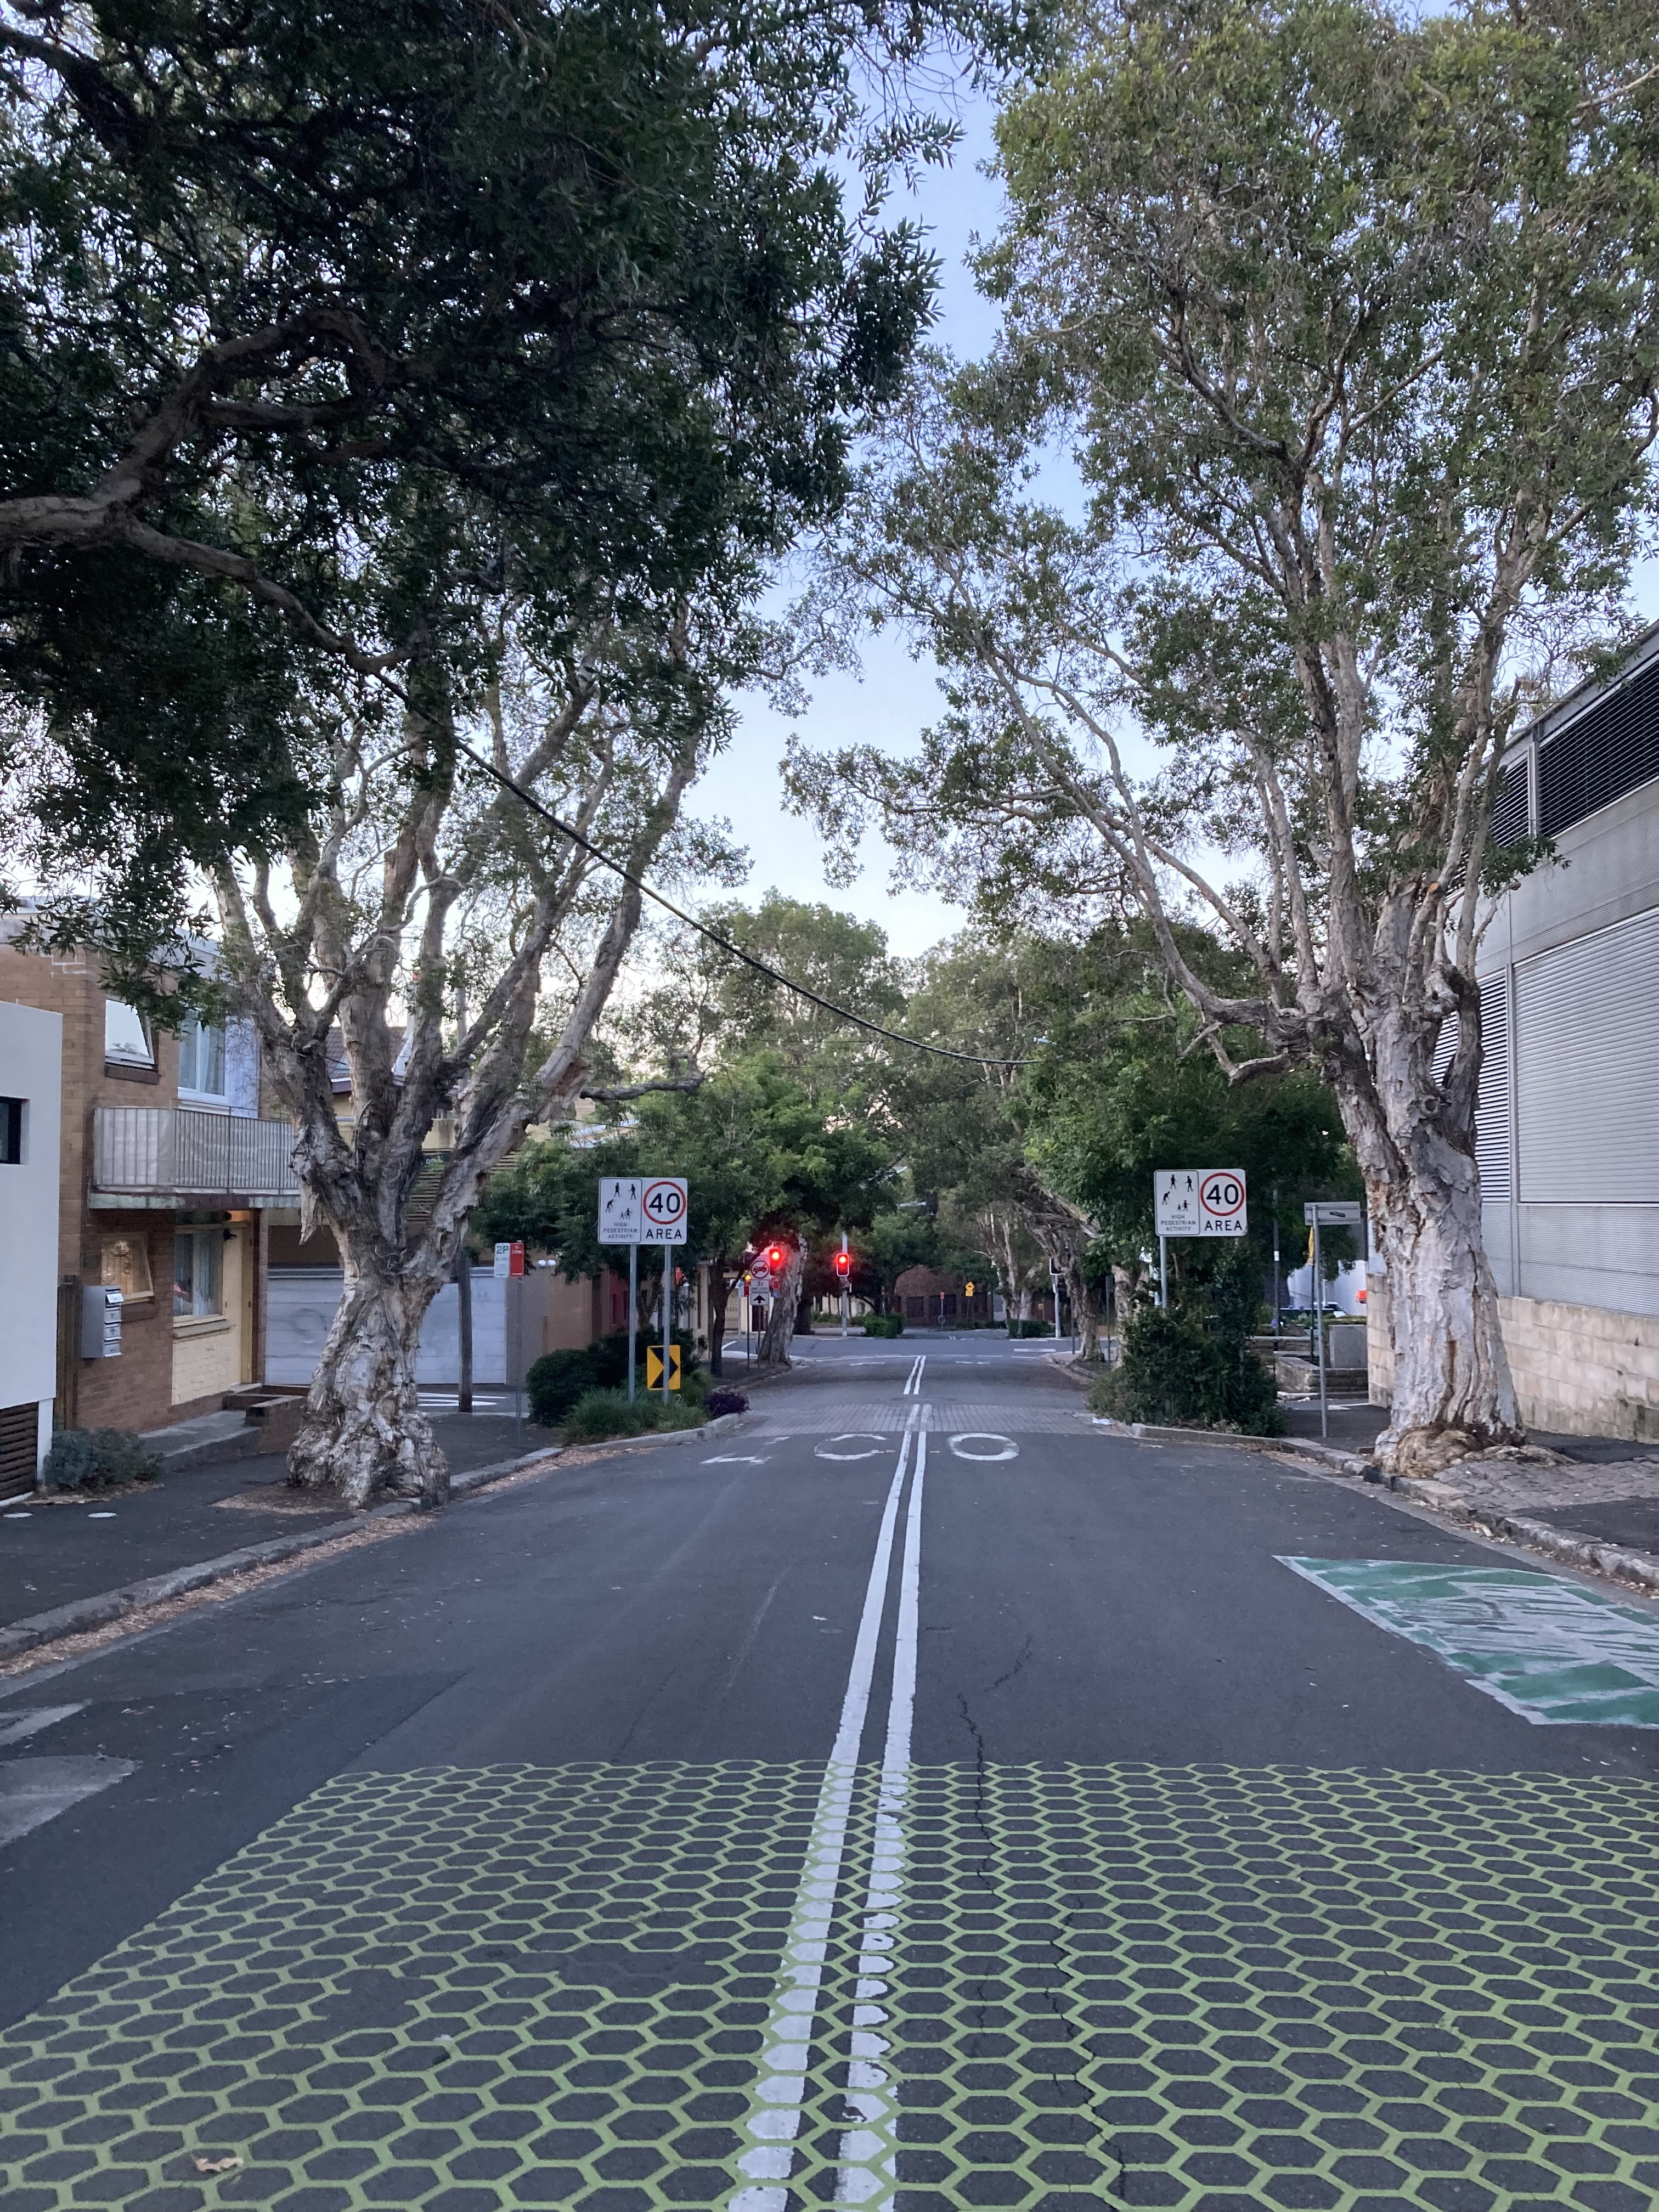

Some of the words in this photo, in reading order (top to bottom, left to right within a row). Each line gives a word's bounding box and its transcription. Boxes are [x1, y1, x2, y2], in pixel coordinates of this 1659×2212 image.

[1206, 1184, 1239, 1205] 40
[648, 1193, 680, 1214] 40
[1204, 1220, 1243, 1231] AREA
[645, 1229, 682, 1239] AREA
[496, 1245, 509, 1254] 2P
